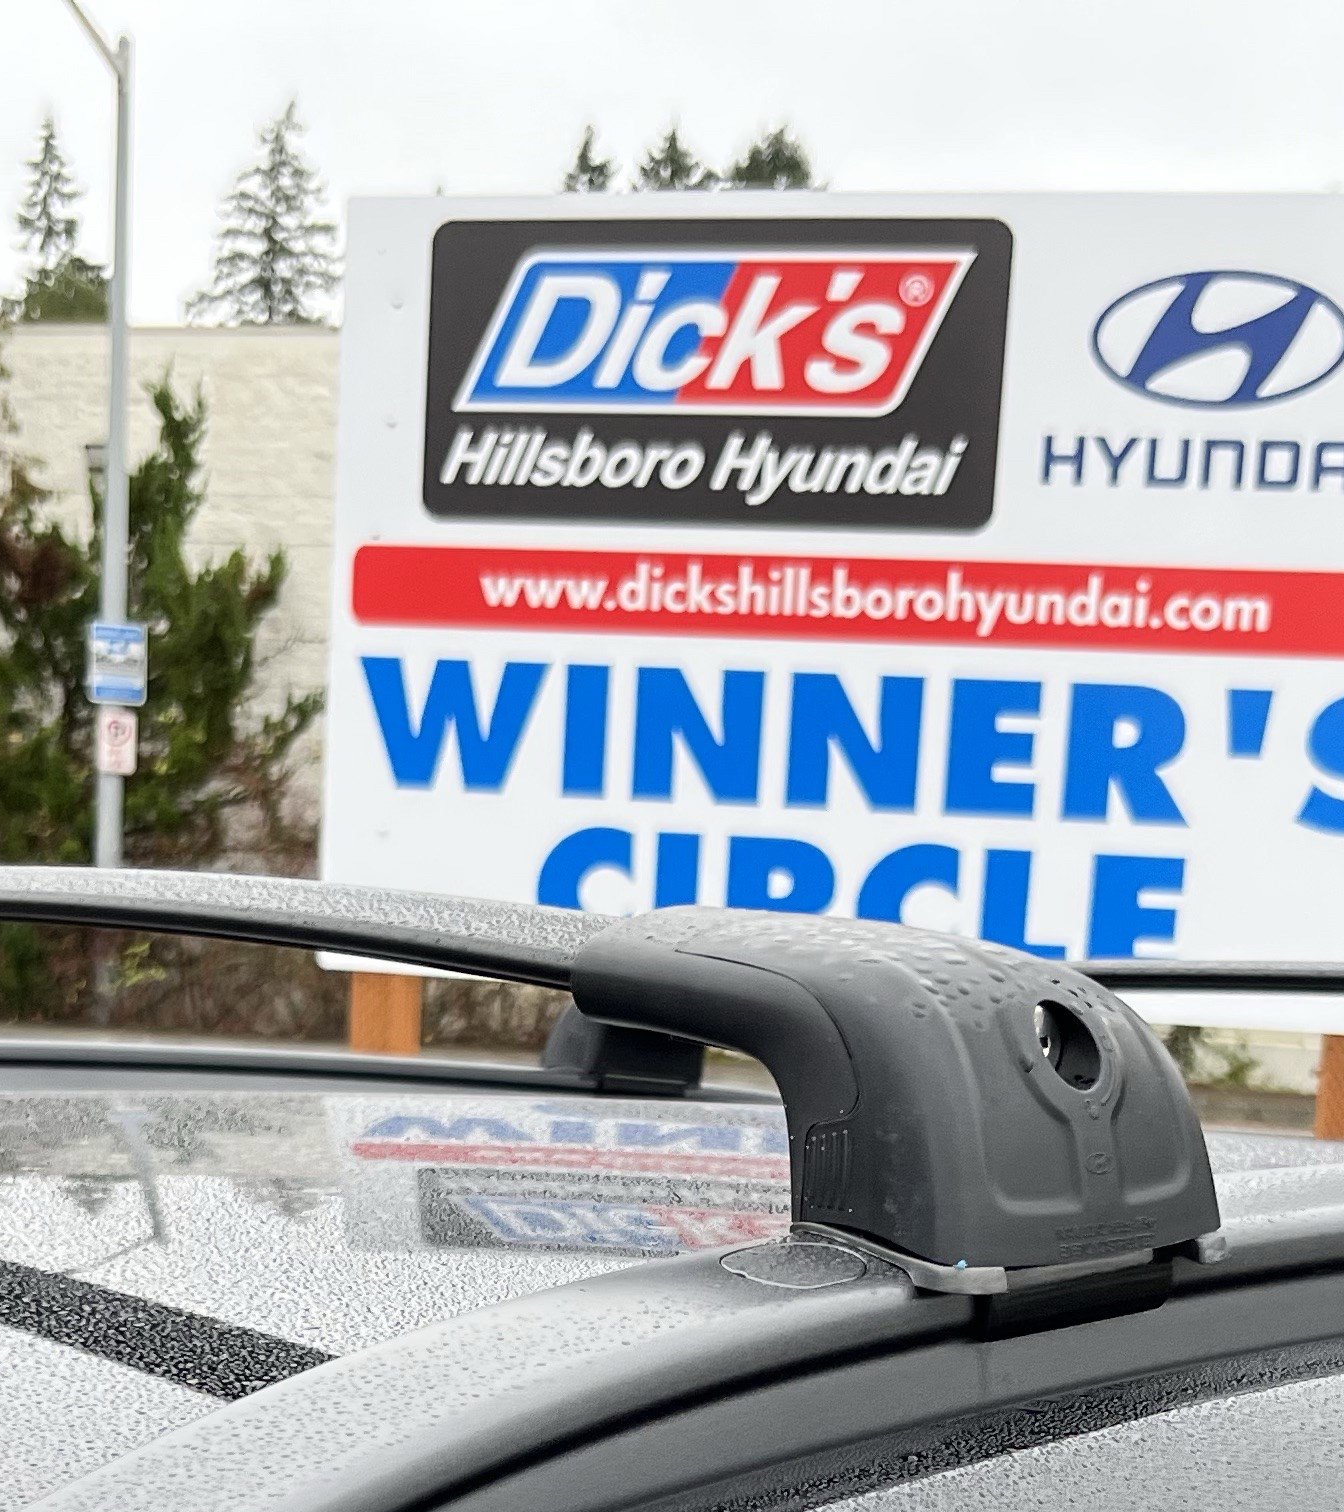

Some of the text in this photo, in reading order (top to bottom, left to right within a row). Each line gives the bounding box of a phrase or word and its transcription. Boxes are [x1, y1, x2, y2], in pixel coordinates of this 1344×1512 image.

[493, 267, 904, 394] Dick's
[440, 427, 969, 505] Hillsboro Hyundai
[480, 562, 1272, 636] www.dickshillsborohyundai.com
